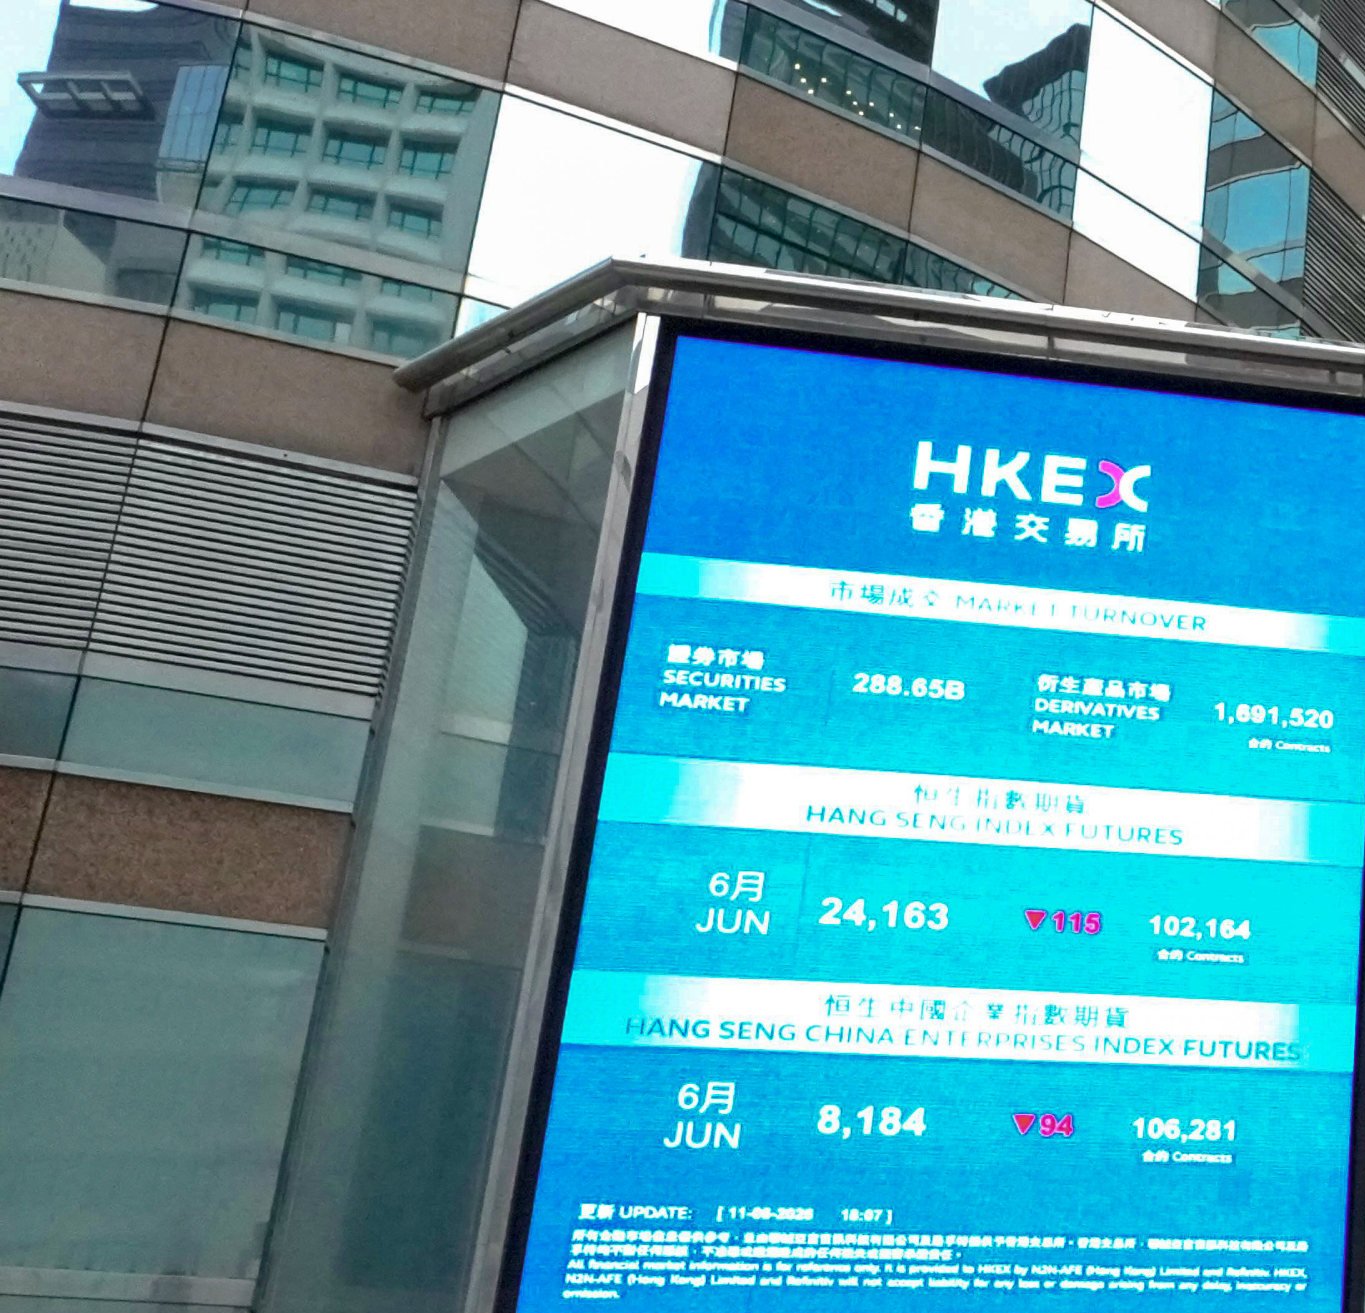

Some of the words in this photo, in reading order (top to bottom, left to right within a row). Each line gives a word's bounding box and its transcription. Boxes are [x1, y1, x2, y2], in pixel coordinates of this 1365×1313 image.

[913, 440, 1152, 513] HKEX
[910, 502, 1147, 553] 香港交易所
[1071, 604, 1207, 631] TURNOVER
[662, 670, 787, 693] SECURITIES
[851, 672, 966, 701] 288.65B
[658, 691, 750, 713] MARKET
[1034, 697, 1160, 721] DERIVATIVES
[1031, 718, 1115, 739] MARKET
[806, 804, 887, 828] HANG
[896, 812, 966, 832] SENG
[1065, 821, 1185, 847] FUTURES
[708, 870, 766, 903] 6月
[695, 906, 772, 937] JUN
[818, 896, 950, 933] 24,163
[1050, 910, 1102, 936] 115
[1147, 914, 1252, 941] 102,164
[624, 1016, 710, 1041] HANG
[718, 1019, 796, 1043] SENG
[804, 1021, 895, 1047] CHINA
[903, 1027, 1086, 1053] ENTERPRISES
[1093, 1034, 1174, 1058] INDEX
[1183, 1037, 1302, 1063] FUTURES
[677, 1080, 738, 1118] 6月
[662, 1119, 742, 1152] JUN
[815, 1103, 928, 1140] 8,184
[1036, 1112, 1075, 1139] 94
[1131, 1116, 1237, 1143] 106,281
[618, 1204, 694, 1221] UPDATE:
